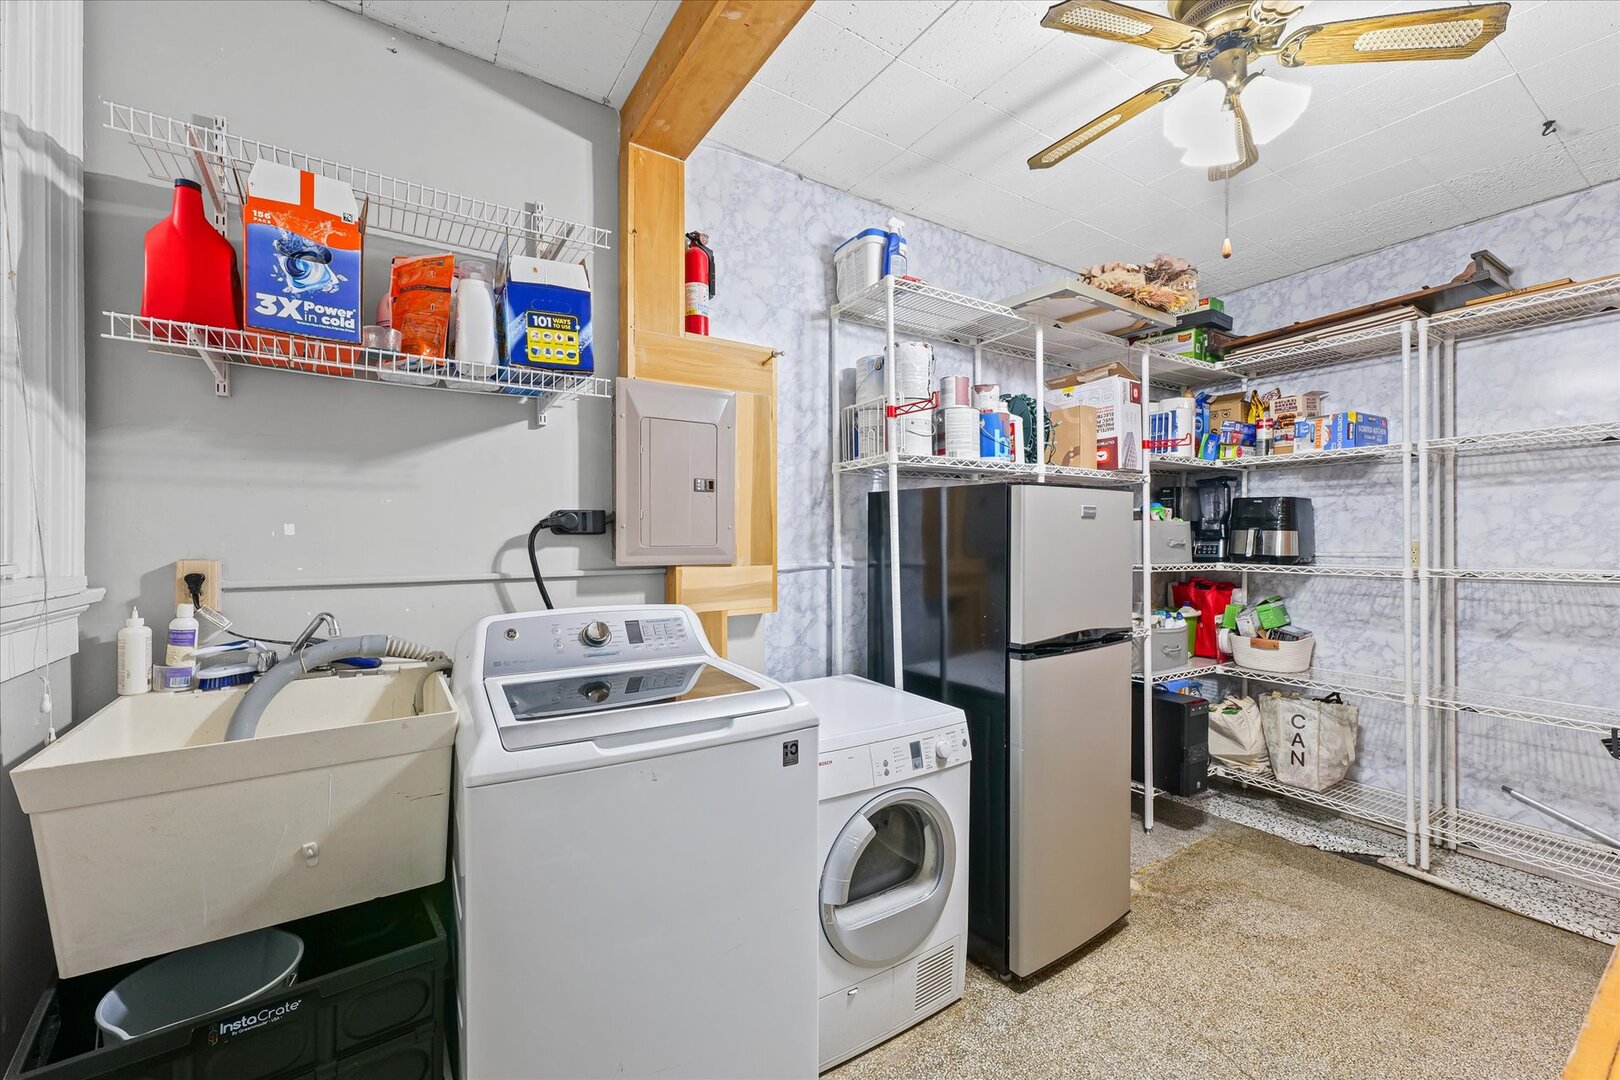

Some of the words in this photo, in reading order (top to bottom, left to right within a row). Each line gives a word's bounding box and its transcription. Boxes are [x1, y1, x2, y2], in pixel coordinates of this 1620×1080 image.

[252, 209, 271, 220] 156
[254, 292, 304, 321] 3X
[303, 301, 355, 319] Power
[304, 311, 317, 323] in
[321, 316, 355, 330] cold
[532, 315, 552, 328] 101
[552, 317, 571, 325] WAYS
[1290, 713, 1306, 768] CAN
[220, 1001, 300, 1035] InstaCrate
